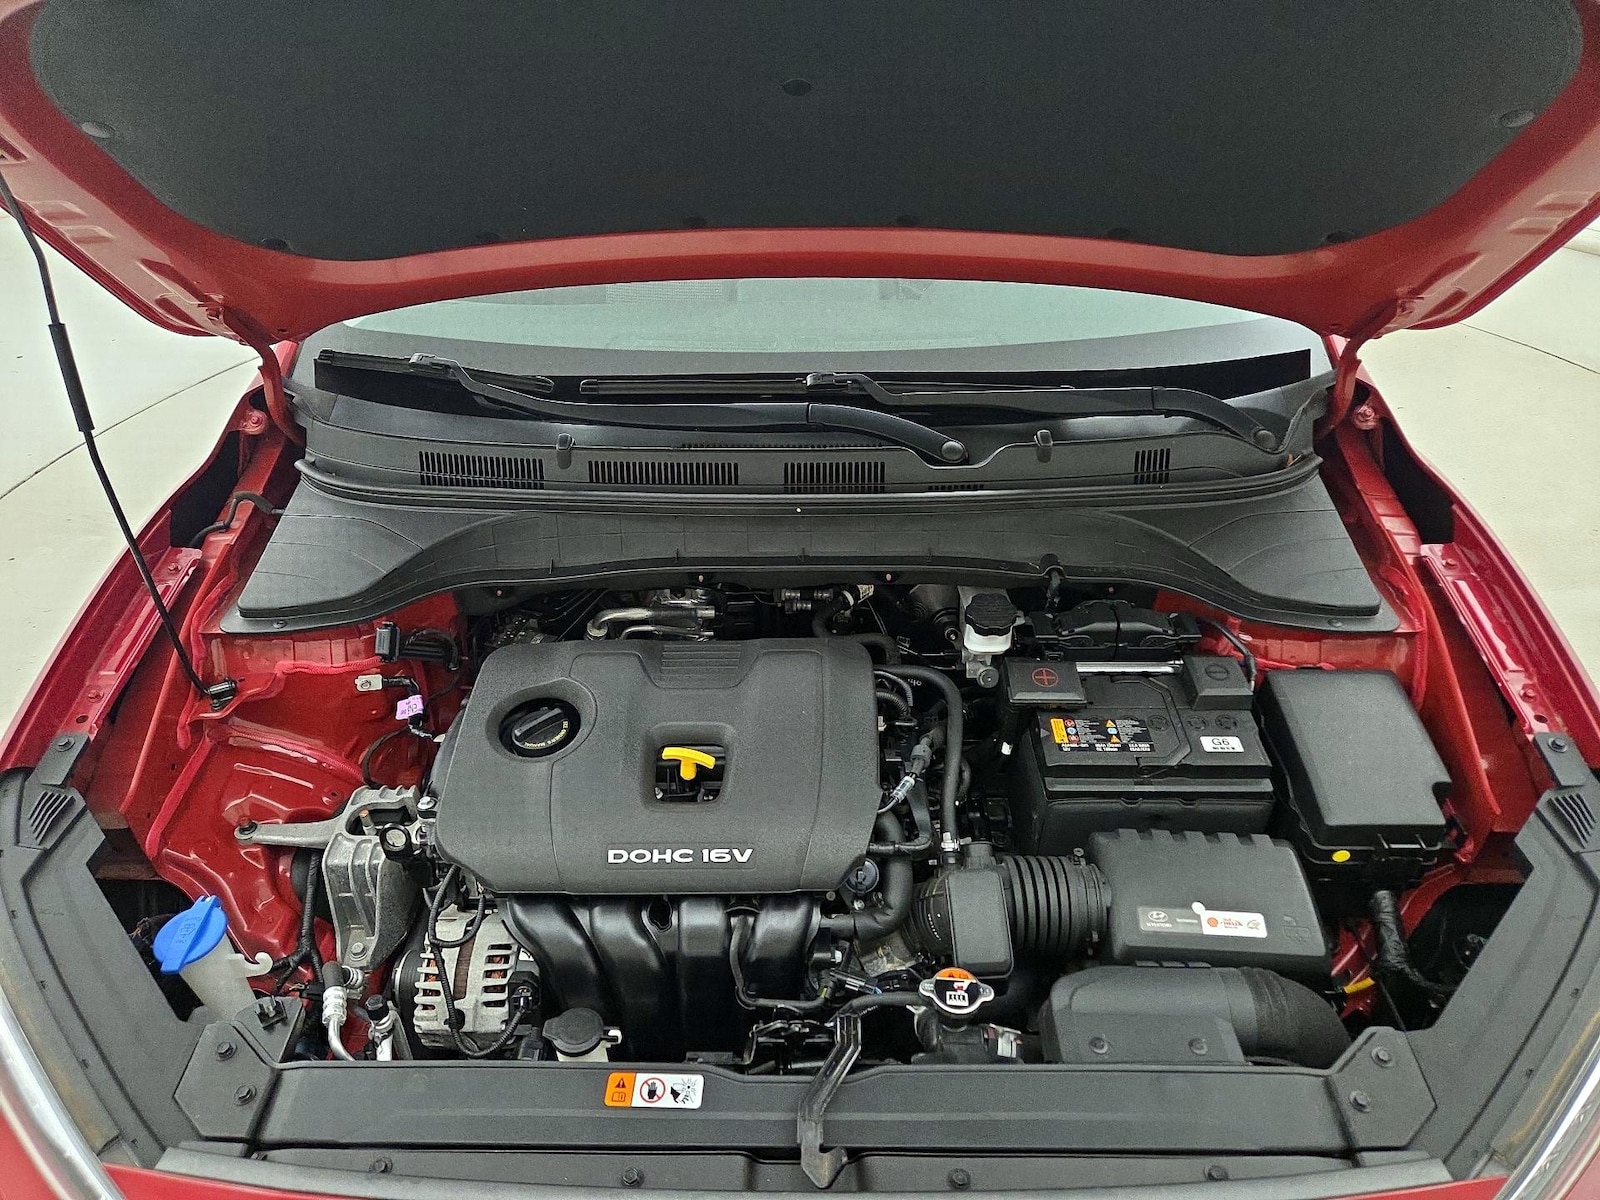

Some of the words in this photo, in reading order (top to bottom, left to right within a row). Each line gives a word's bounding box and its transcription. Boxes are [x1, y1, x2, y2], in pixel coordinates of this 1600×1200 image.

[1211, 738, 1230, 746] G6
[607, 848, 694, 864] DOHC
[702, 848, 754, 863] 16V
